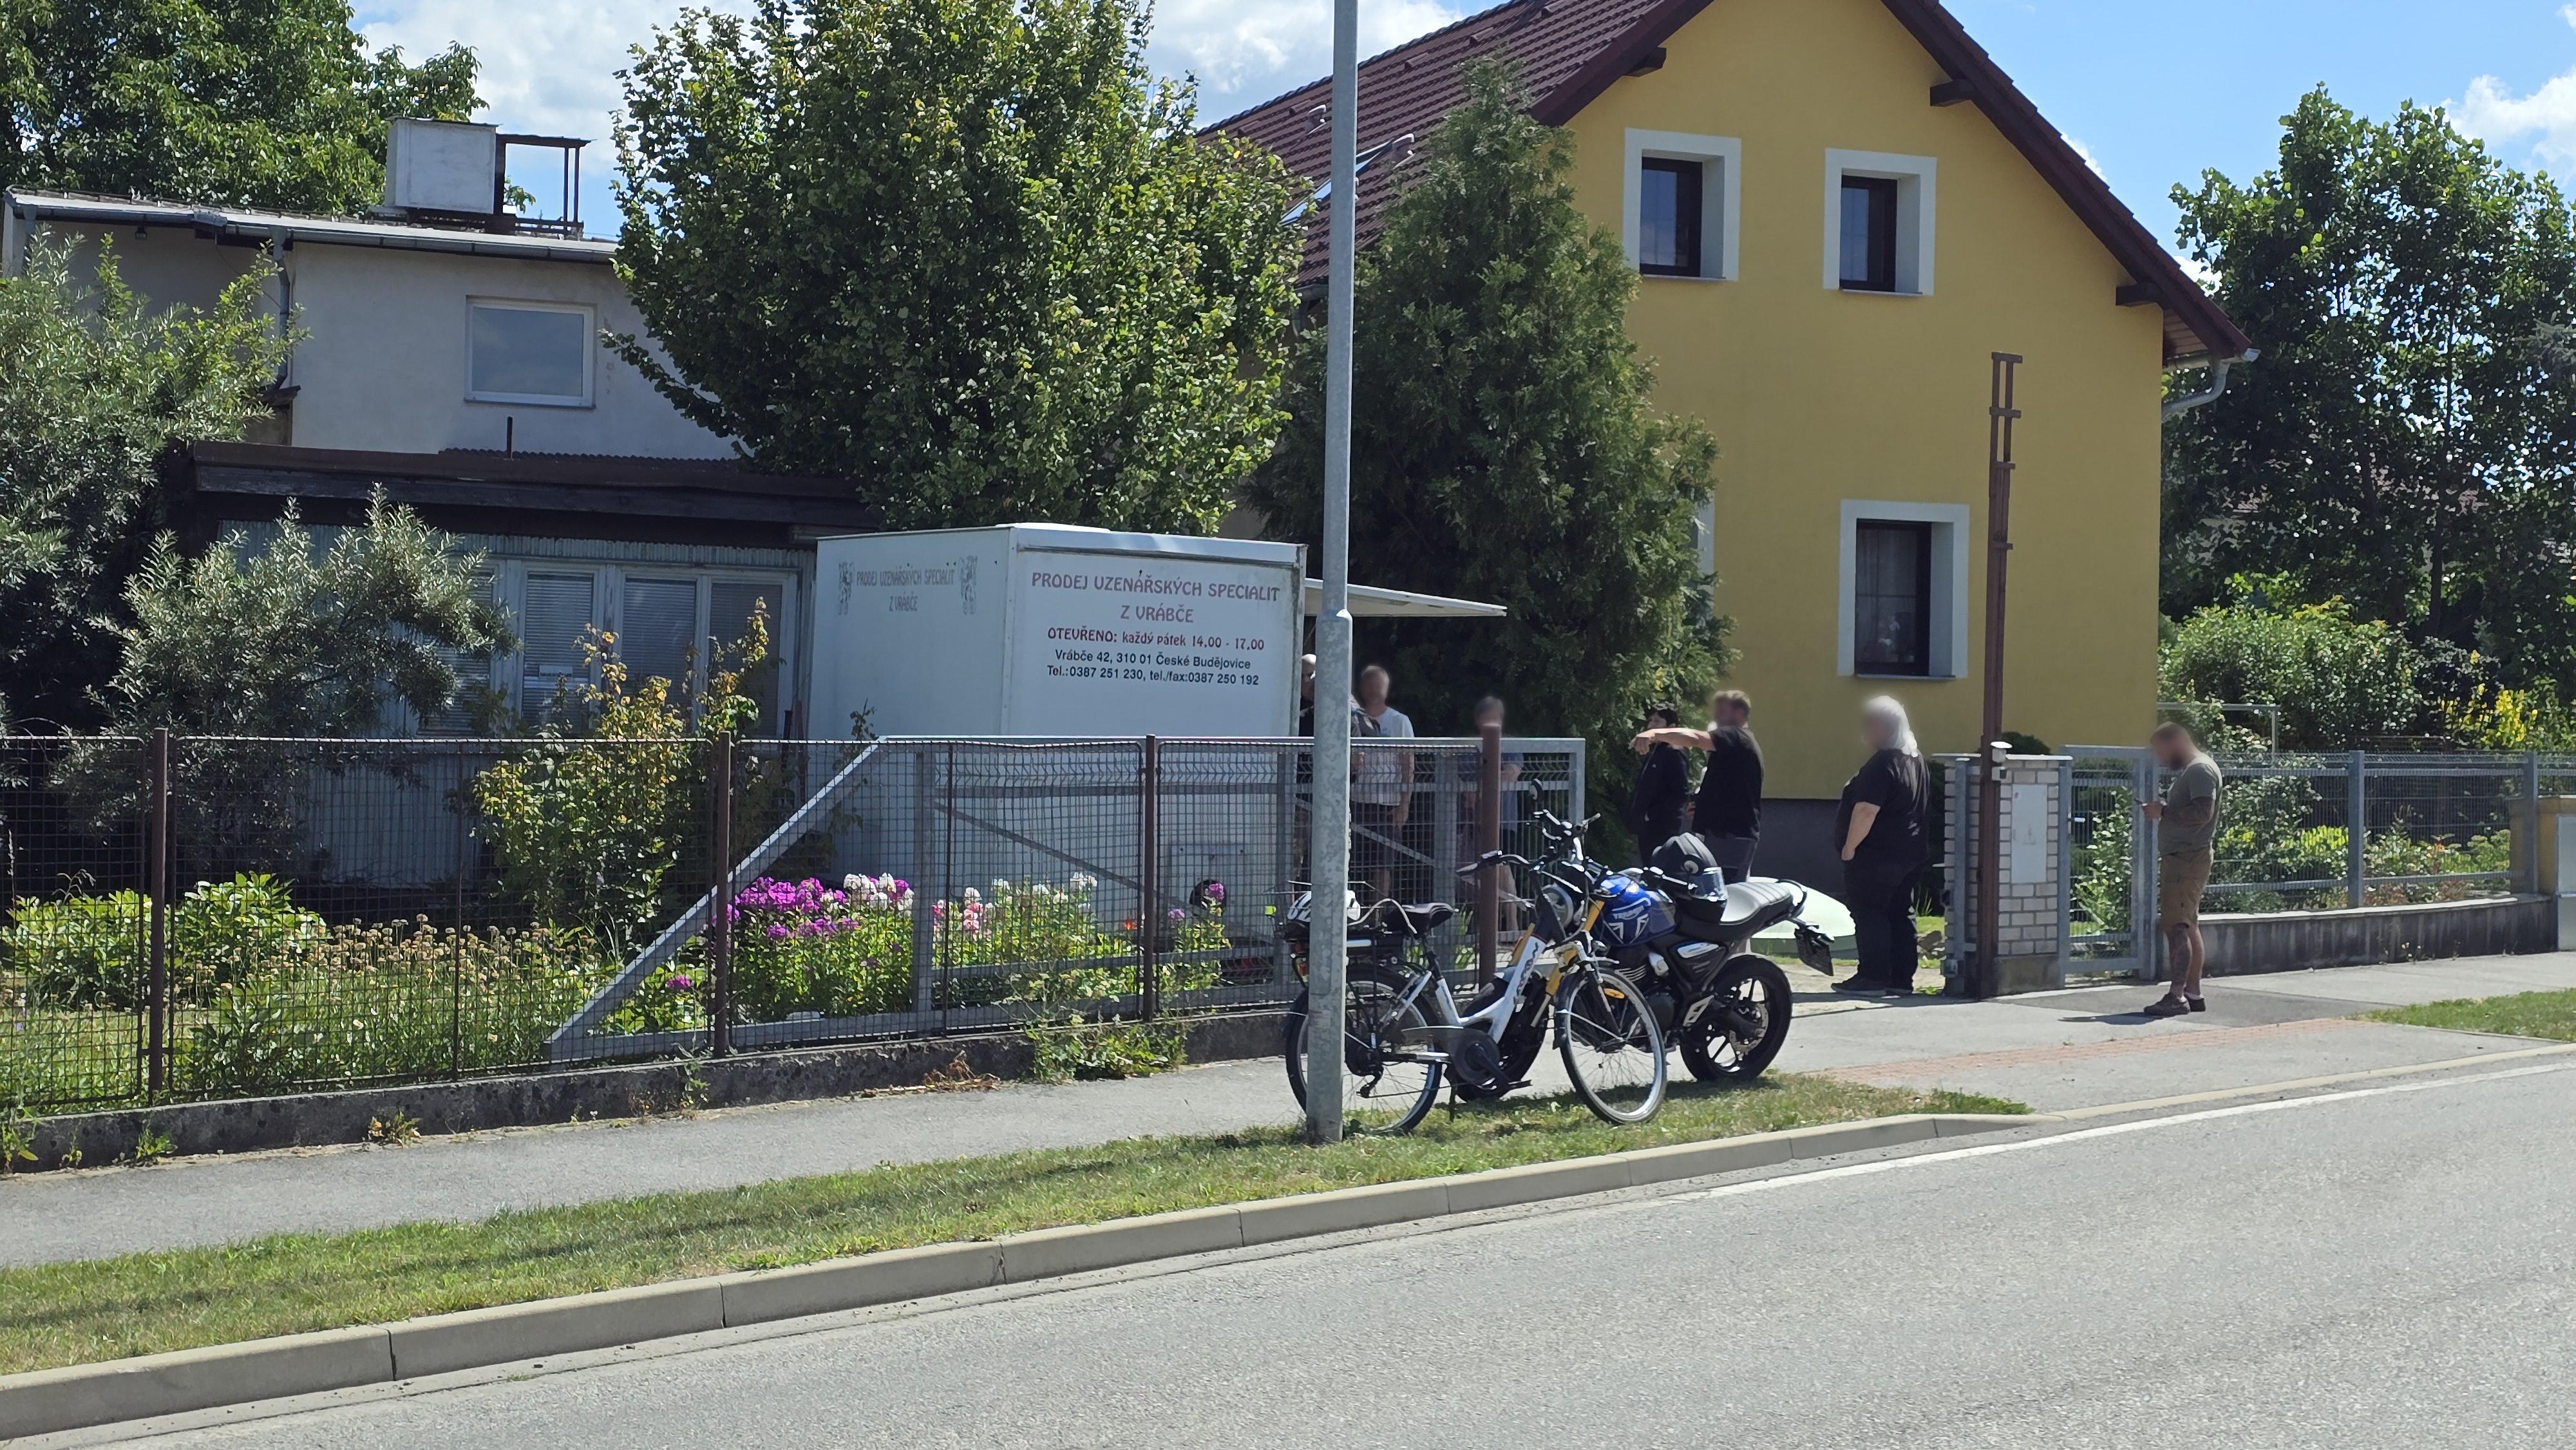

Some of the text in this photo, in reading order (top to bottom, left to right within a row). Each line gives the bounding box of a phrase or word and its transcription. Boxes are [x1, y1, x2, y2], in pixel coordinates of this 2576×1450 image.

[1032, 572, 1280, 601] PRODEJ UZENÁŘSKÝCH SPECIALIT
[1120, 603, 1194, 623] Z VRÁBČE
[1048, 625, 1117, 643] OTEVŘENO:
[1122, 631, 1153, 645] každý
[1157, 632, 1186, 646] pátek
[1055, 648, 1251, 670] Vrábče 42, 310 01 České Budějovice
[1100, 668, 1119, 679] 251
[1123, 669, 1146, 681] 230,
[1217, 673, 1236, 684] 250
[1241, 675, 1259, 686] 192
